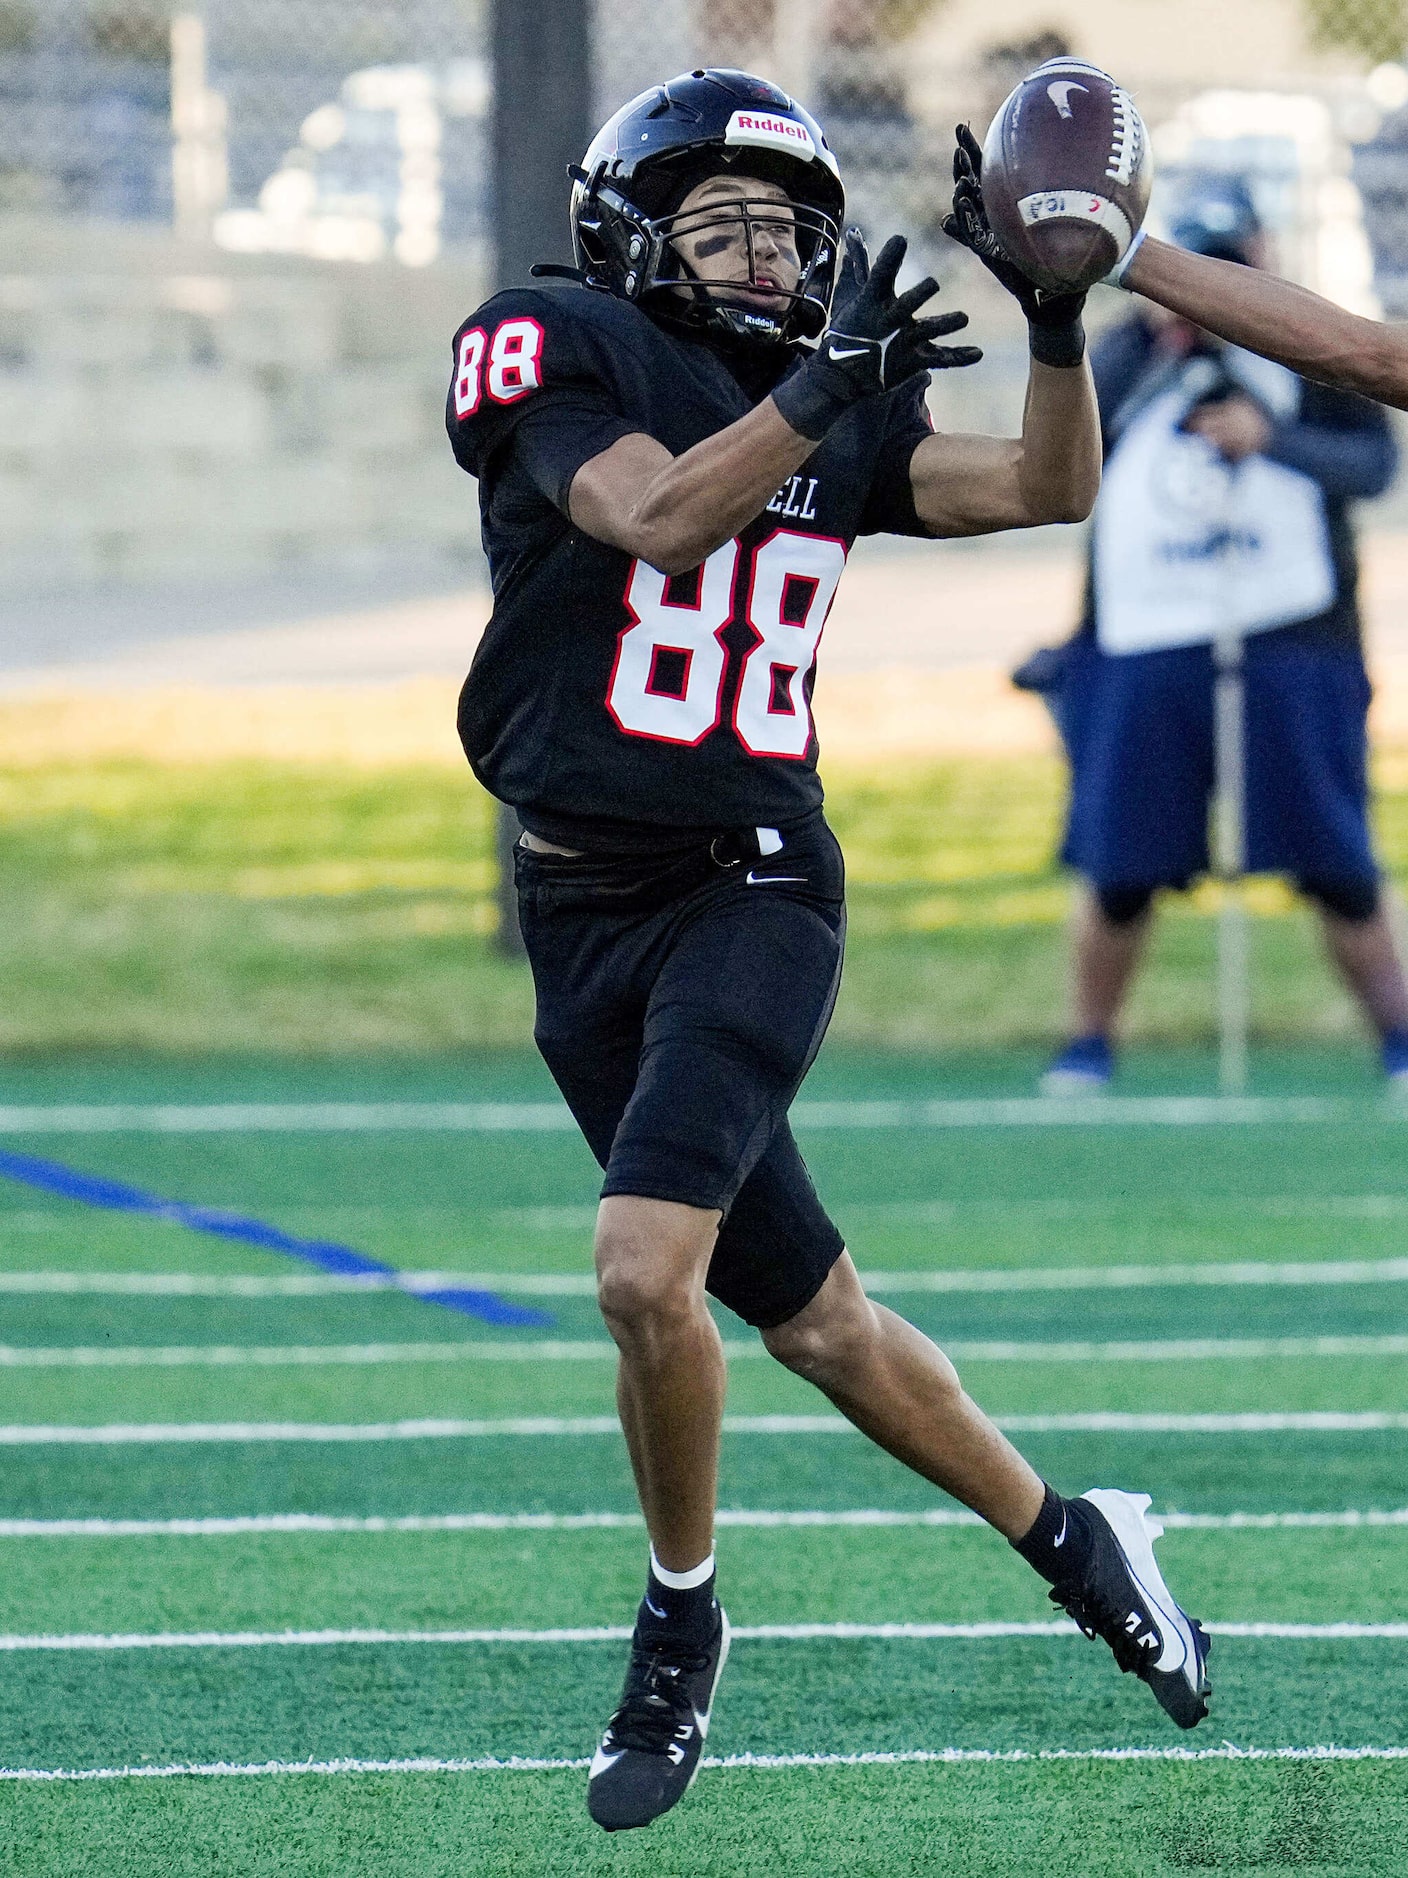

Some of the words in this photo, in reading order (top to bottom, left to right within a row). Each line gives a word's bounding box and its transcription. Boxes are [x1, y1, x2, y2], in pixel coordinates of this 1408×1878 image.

[738, 116, 807, 141] Riddell
[454, 316, 545, 421] 88
[604, 527, 848, 760] 88
